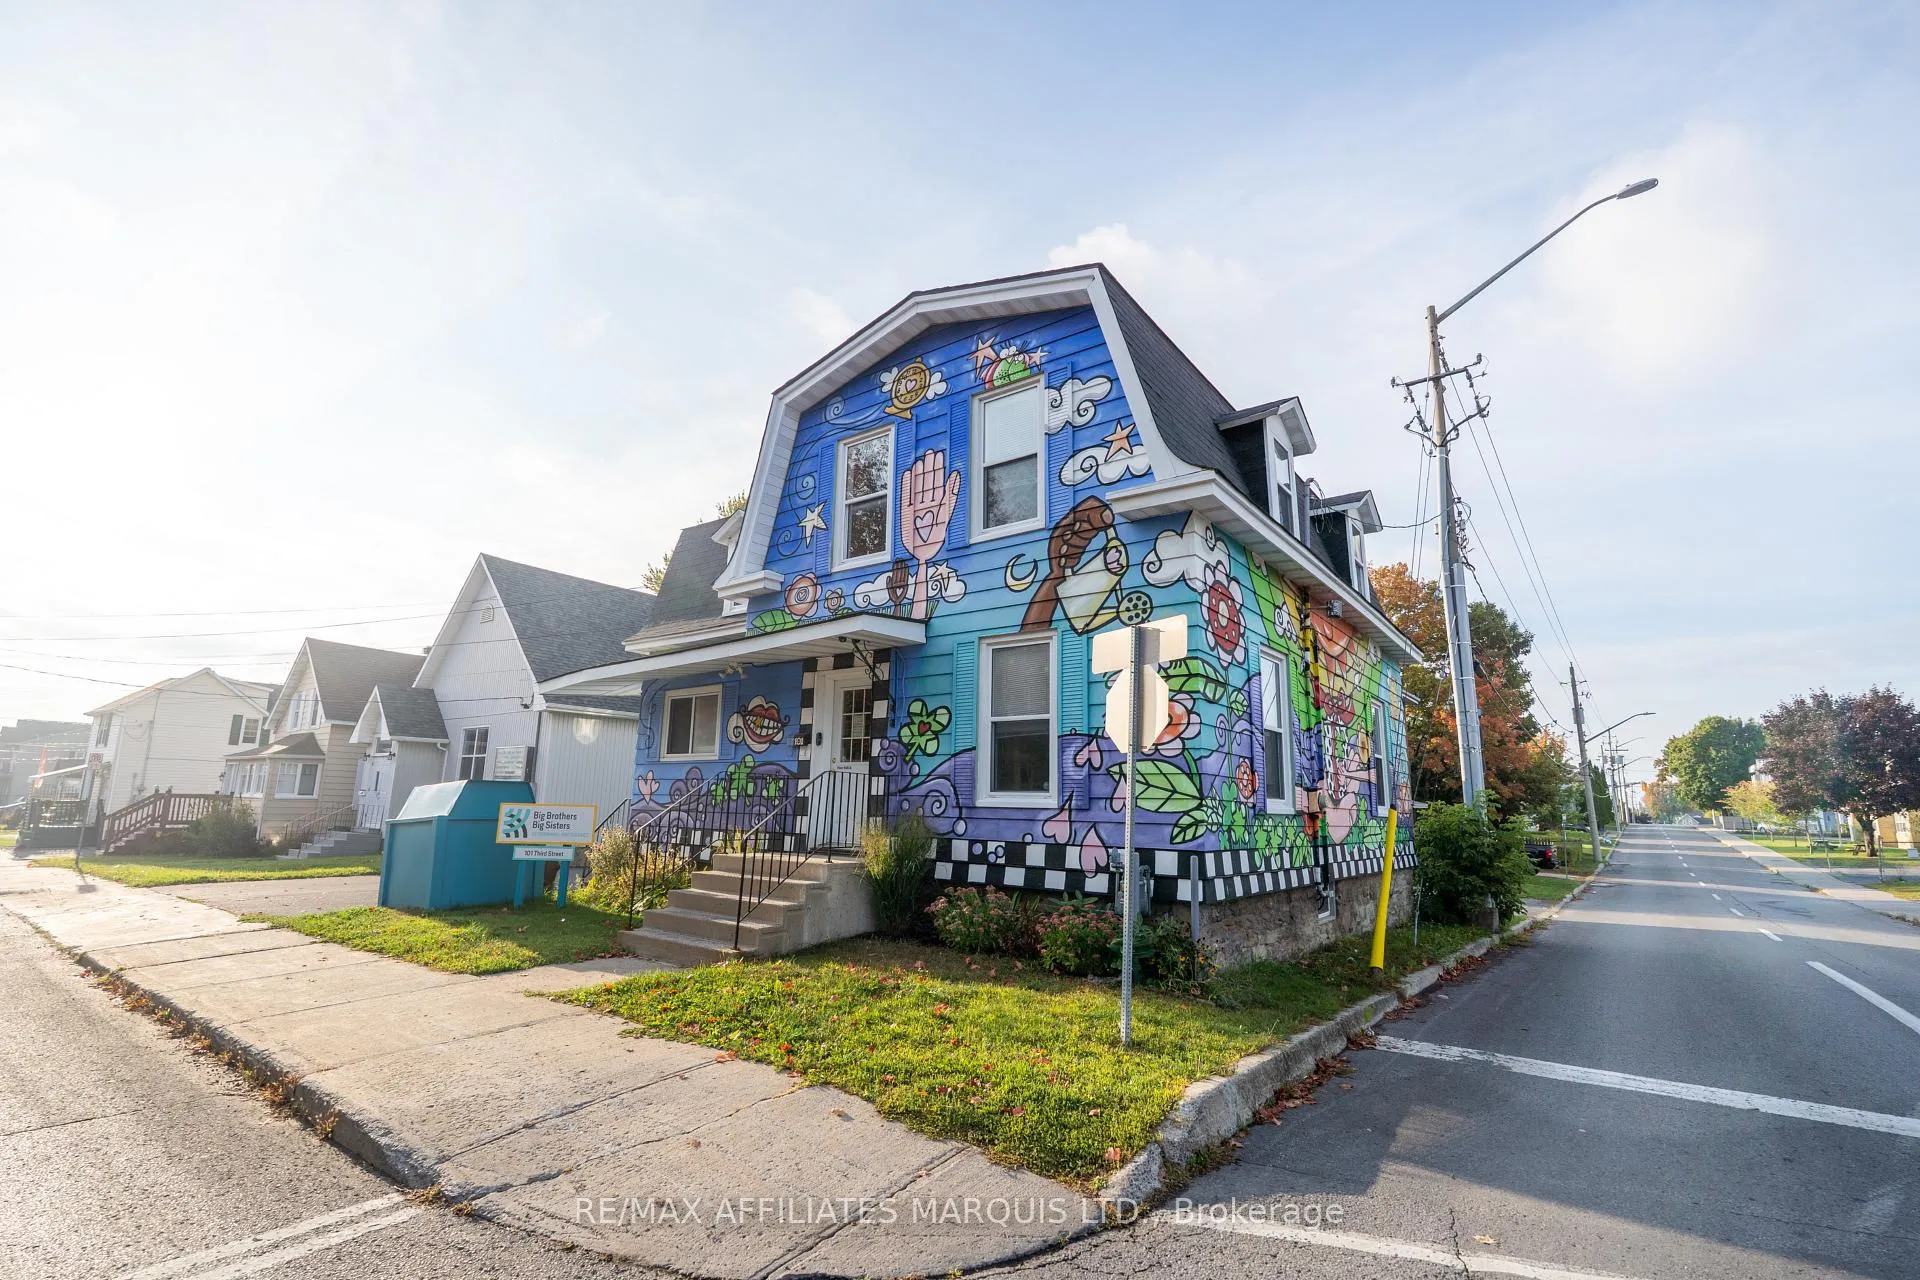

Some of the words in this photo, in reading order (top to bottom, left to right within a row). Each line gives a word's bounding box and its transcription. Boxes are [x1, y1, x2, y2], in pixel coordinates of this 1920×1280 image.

[533, 811, 545, 821] Big
[546, 811, 577, 820] Brothers
[532, 821, 544, 831] Big
